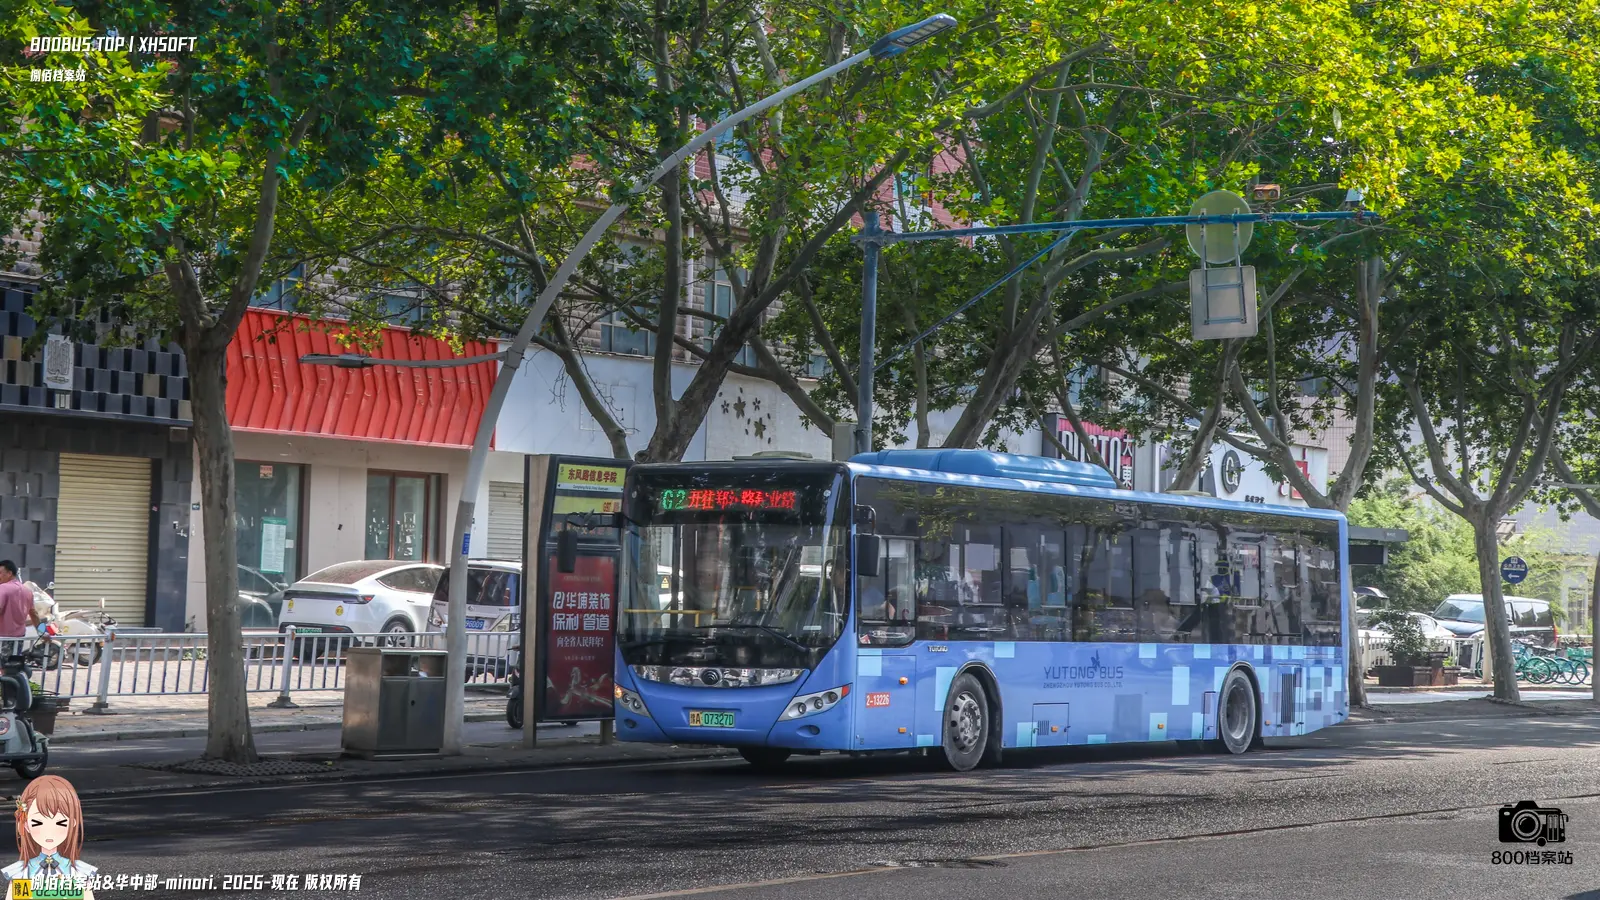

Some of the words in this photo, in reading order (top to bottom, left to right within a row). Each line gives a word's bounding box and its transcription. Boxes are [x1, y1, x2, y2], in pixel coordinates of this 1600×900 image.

[1122, 434, 1133, 487] 大東
[568, 468, 618, 483] 东风路信息学院
[661, 489, 686, 510] G2
[1043, 666, 1096, 679] YUTONG
[1099, 666, 1124, 679] BUS
[866, 695, 890, 706] 2-13226
